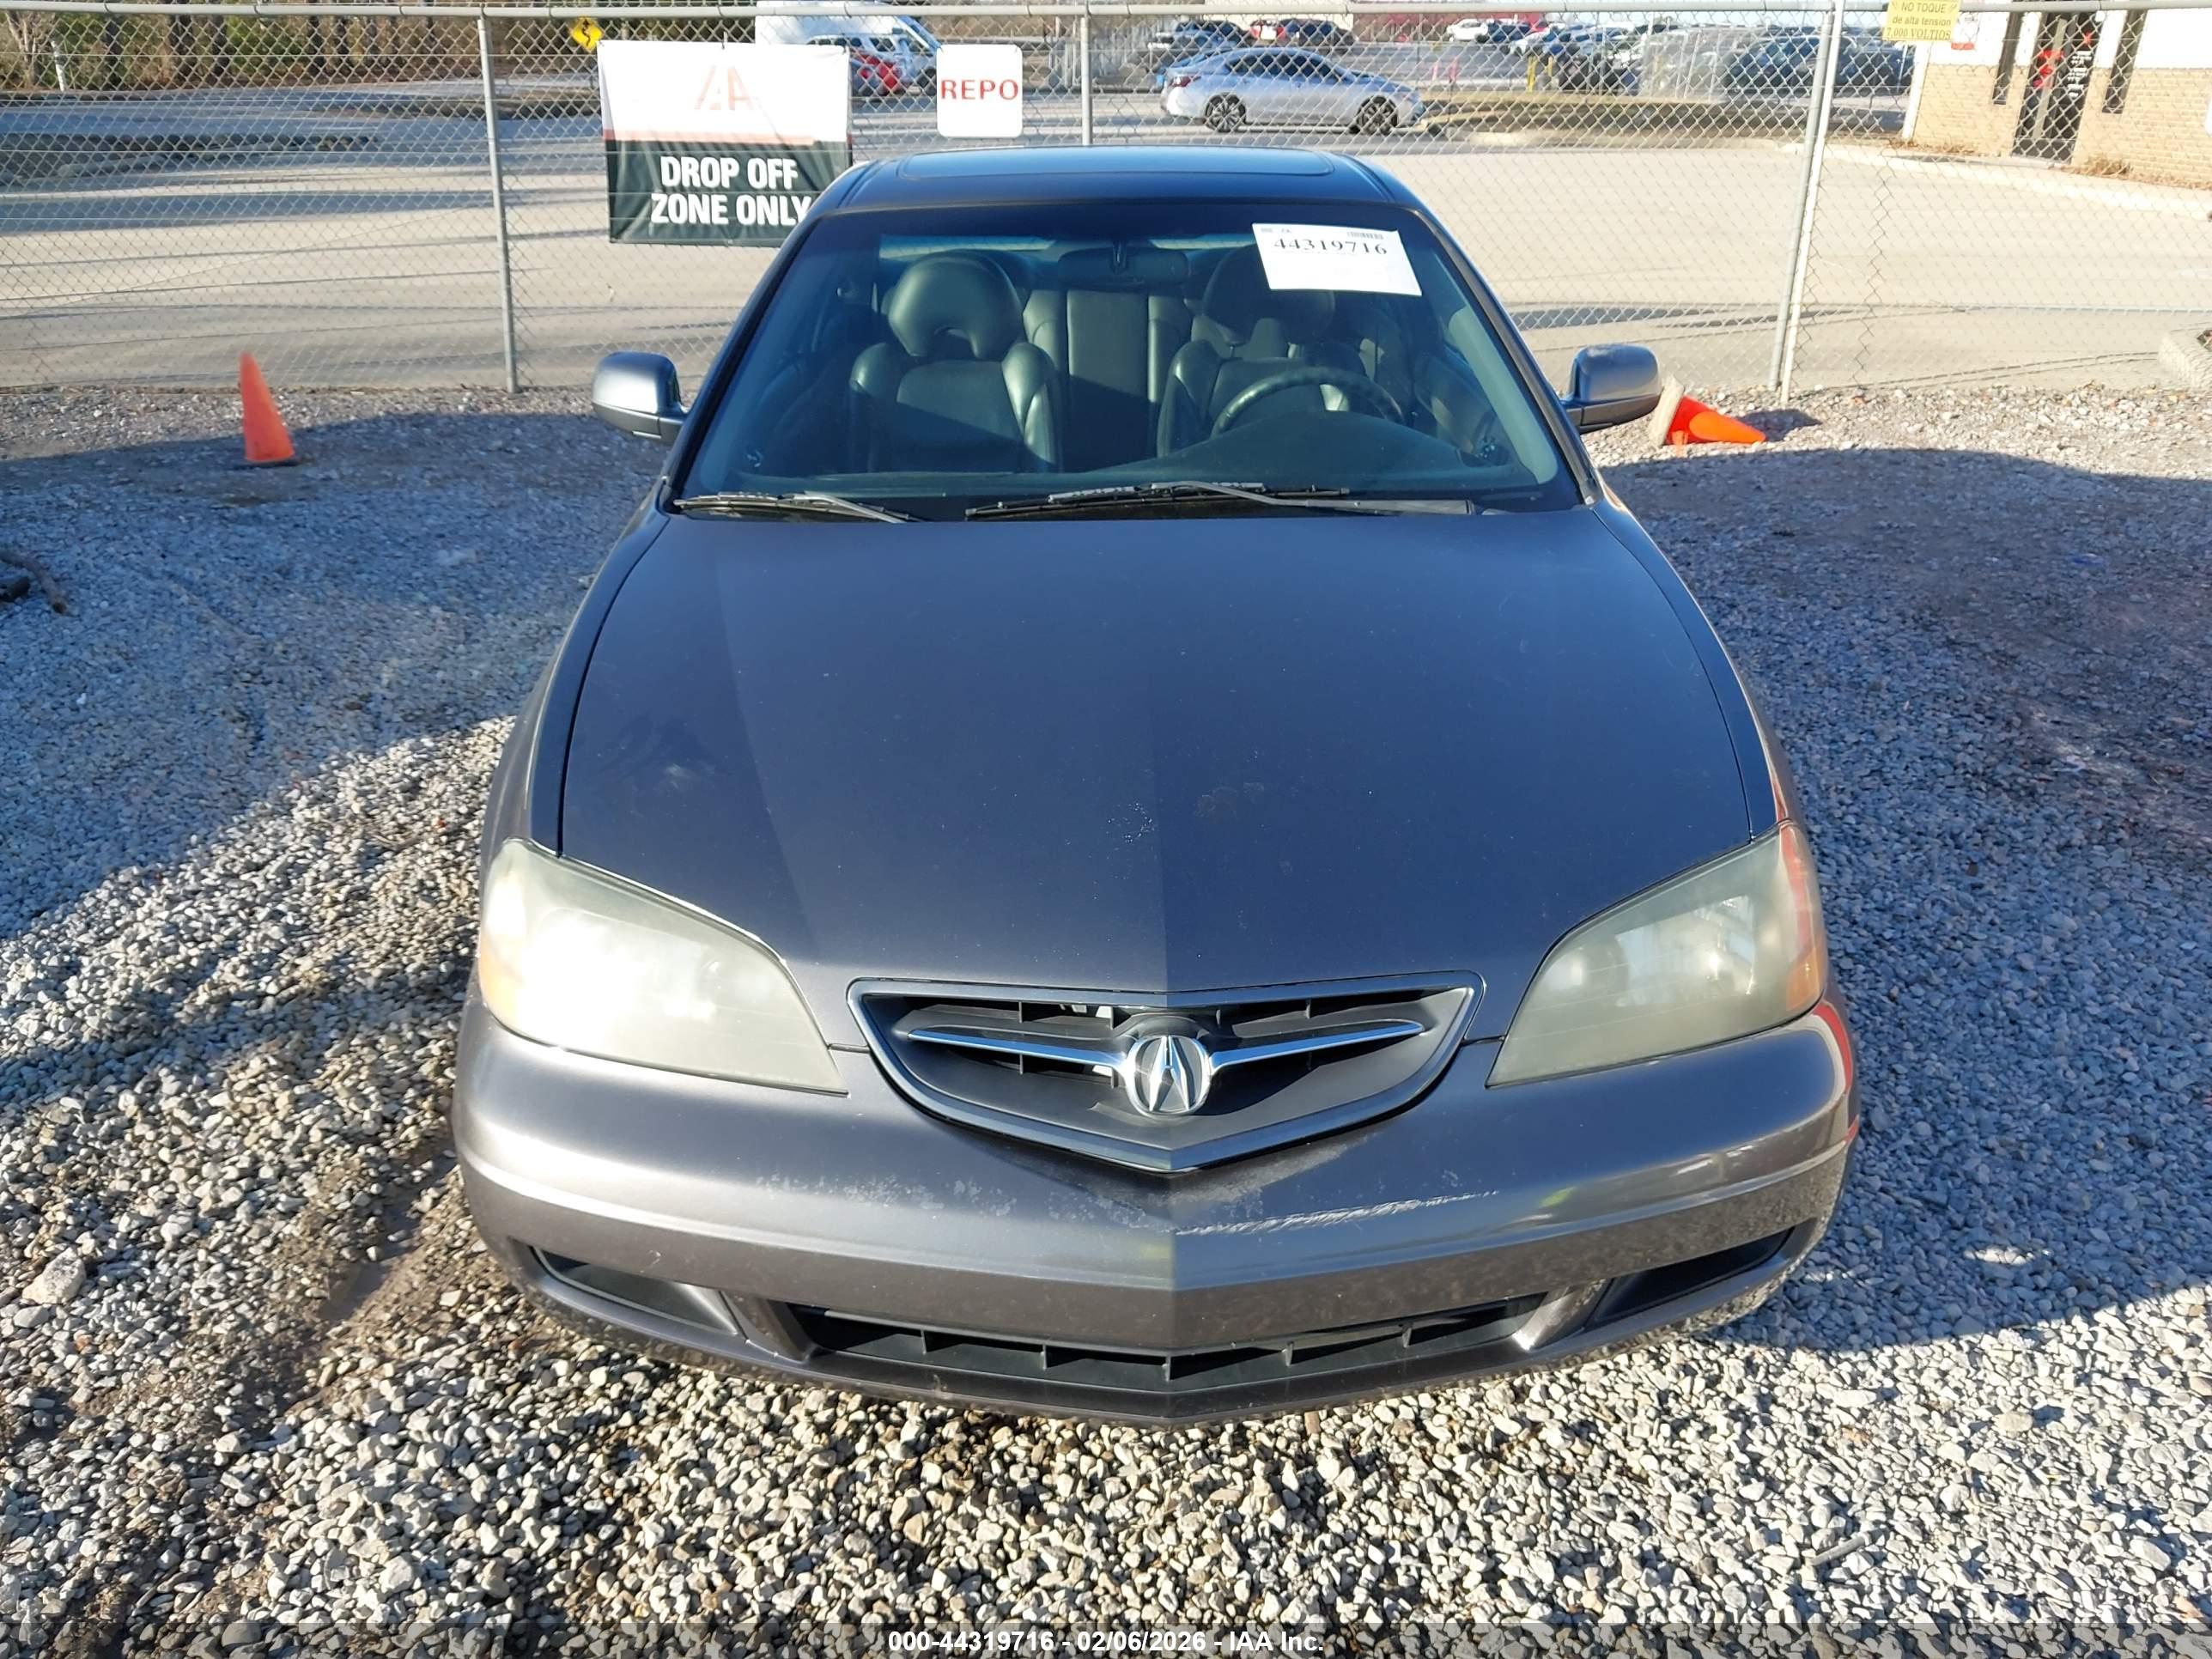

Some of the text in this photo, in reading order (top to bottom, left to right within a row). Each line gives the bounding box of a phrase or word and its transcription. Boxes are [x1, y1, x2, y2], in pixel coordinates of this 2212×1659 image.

[1917, 3, 1948, 14] TOQUE
[1892, 15, 1903, 24] de
[1904, 15, 1920, 25] alta
[1911, 28, 1952, 41] VOLTIOS
[940, 78, 1019, 100] REPO
[659, 155, 799, 190] DROP OFF
[650, 192, 812, 227] ZONE ONLY
[1273, 237, 1388, 255] 44319716
